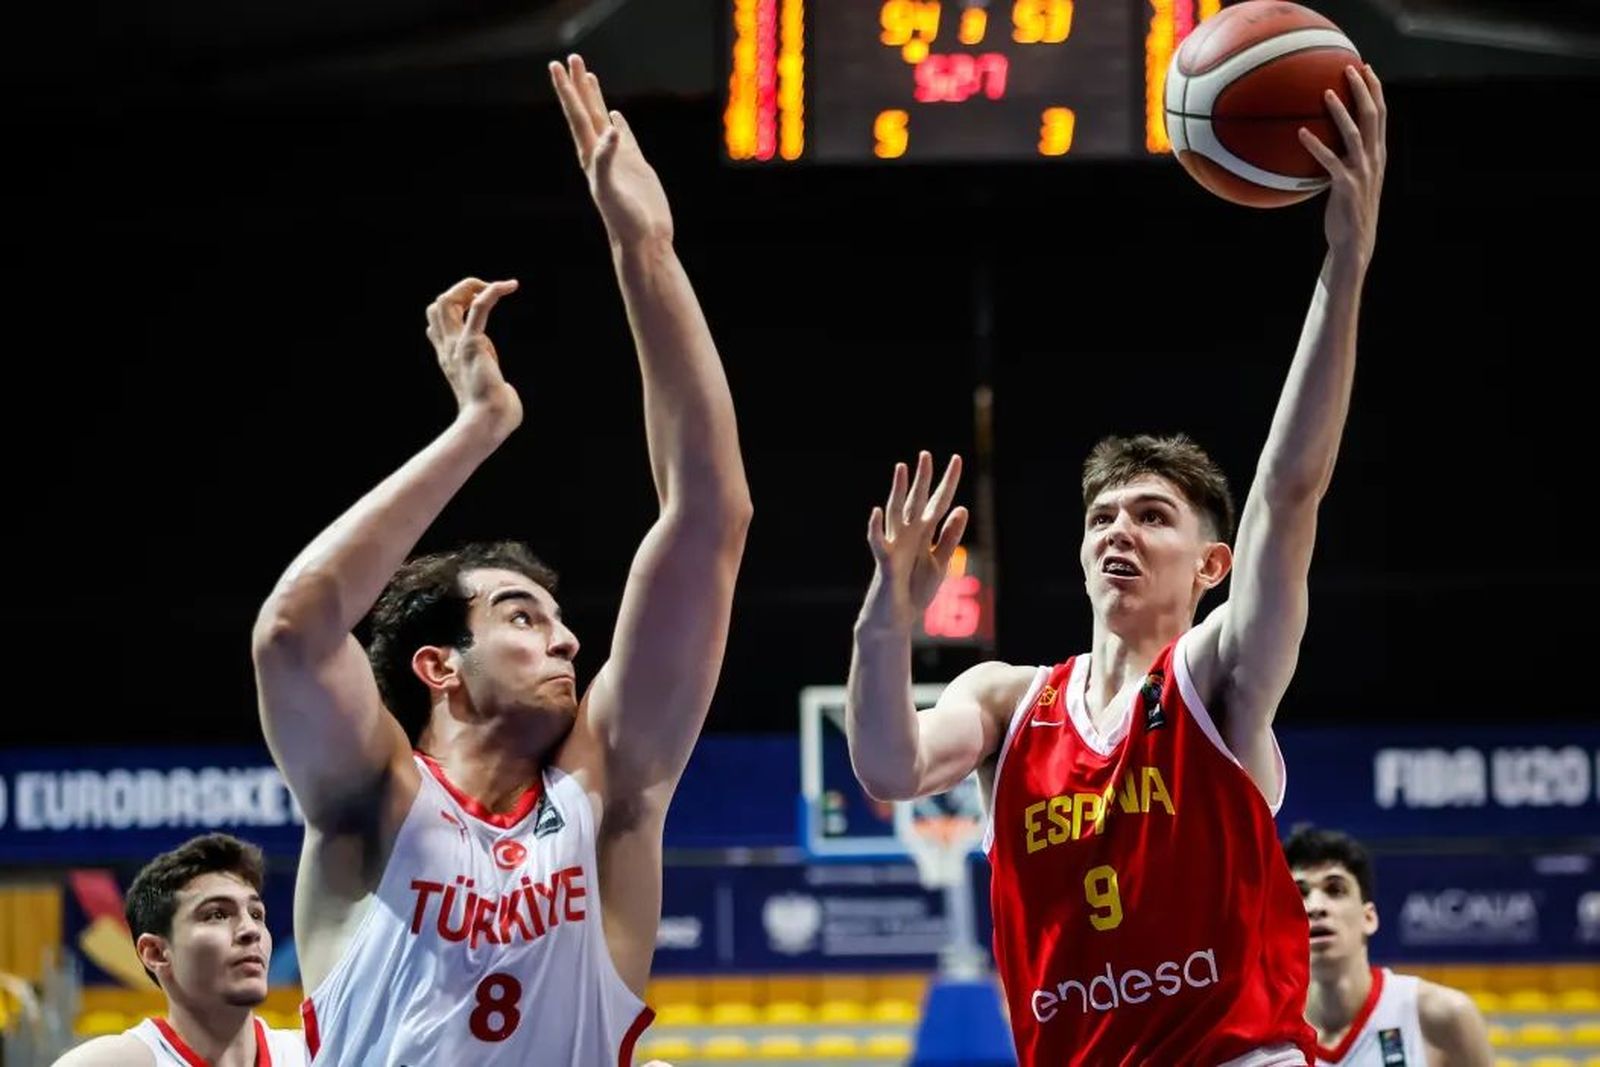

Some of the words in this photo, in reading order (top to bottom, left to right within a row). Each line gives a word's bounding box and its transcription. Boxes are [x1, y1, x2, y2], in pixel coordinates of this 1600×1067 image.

[410, 866, 587, 950] TÜRKİYE
[1083, 864, 1124, 932] 9
[469, 972, 523, 1043] 8
[1031, 947, 1220, 1023] endesa
